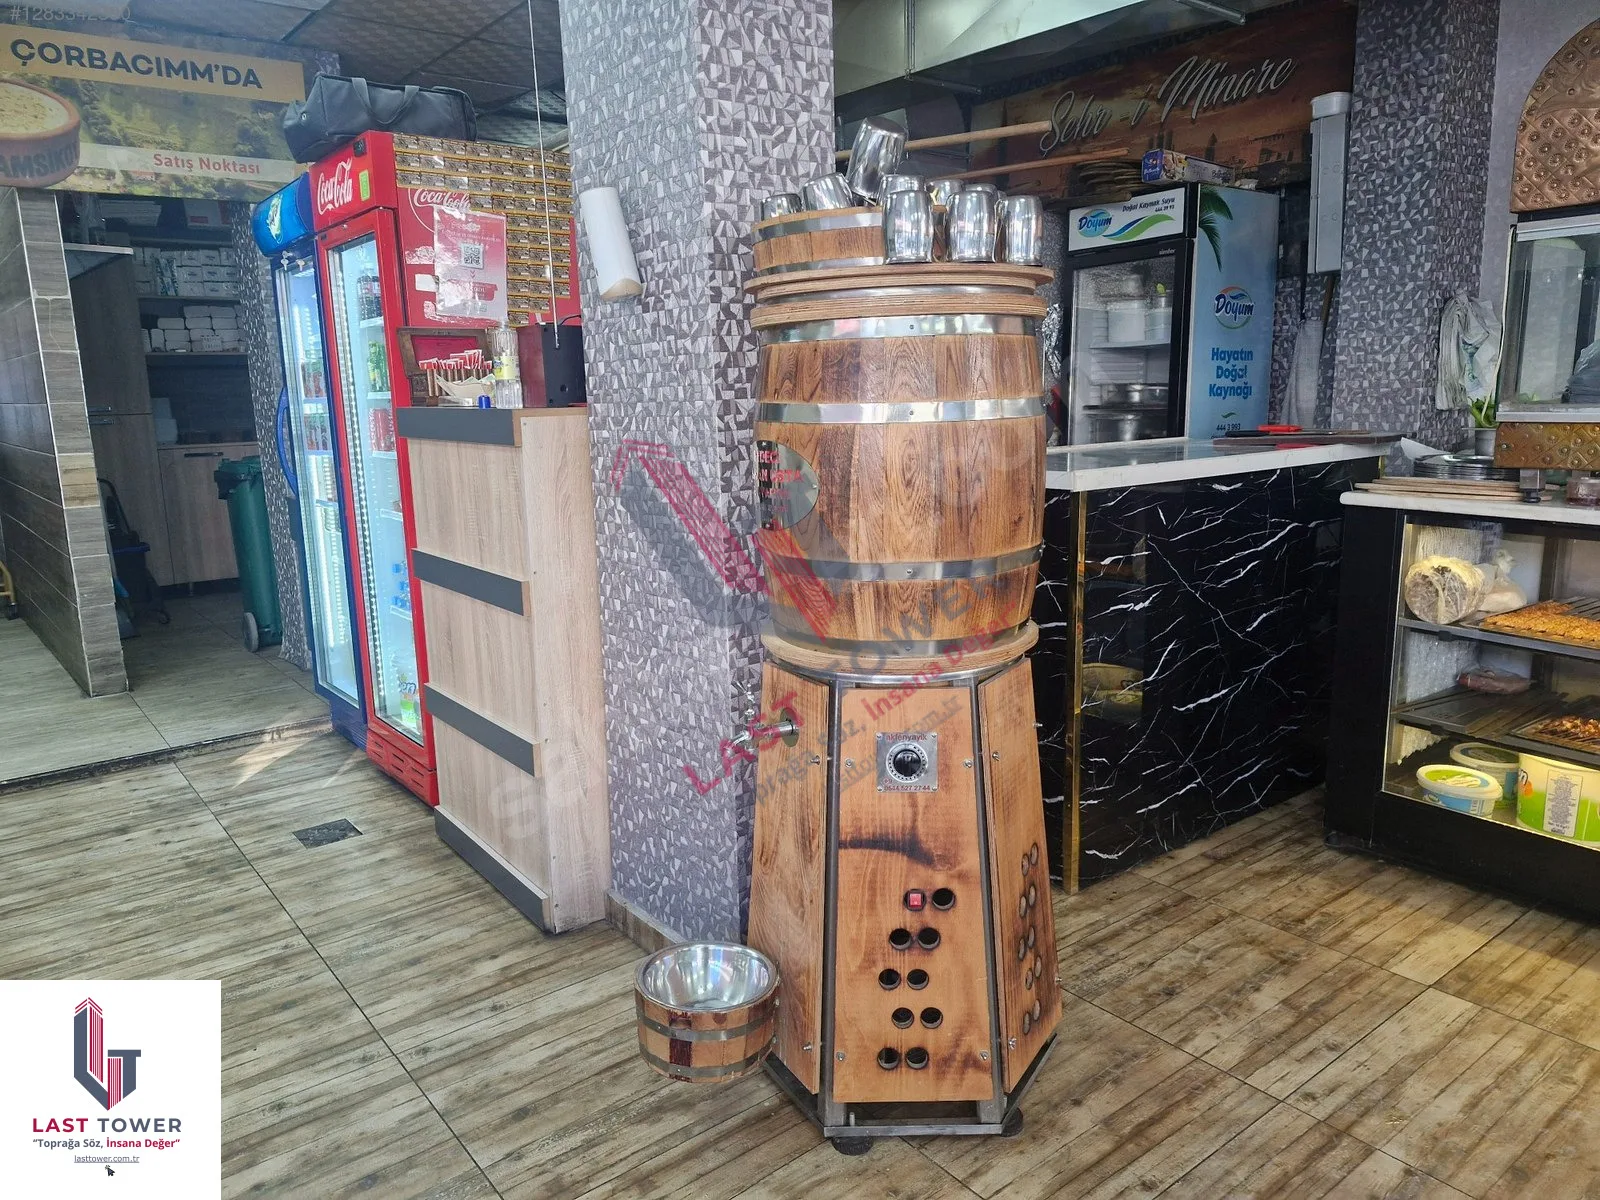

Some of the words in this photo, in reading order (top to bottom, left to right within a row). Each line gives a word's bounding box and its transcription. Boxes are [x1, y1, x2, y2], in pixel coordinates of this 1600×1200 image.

[1157, 55, 1294, 124] Minare
[153, 153, 194, 172] Satış
[199, 157, 260, 174] Noktası
[1078, 216, 1112, 232] Doyum
[1214, 293, 1254, 322] Doyum
[1211, 347, 1254, 364] Hayatın
[1216, 364, 1247, 382] Doğal
[1208, 381, 1252, 400] Kaynağı
